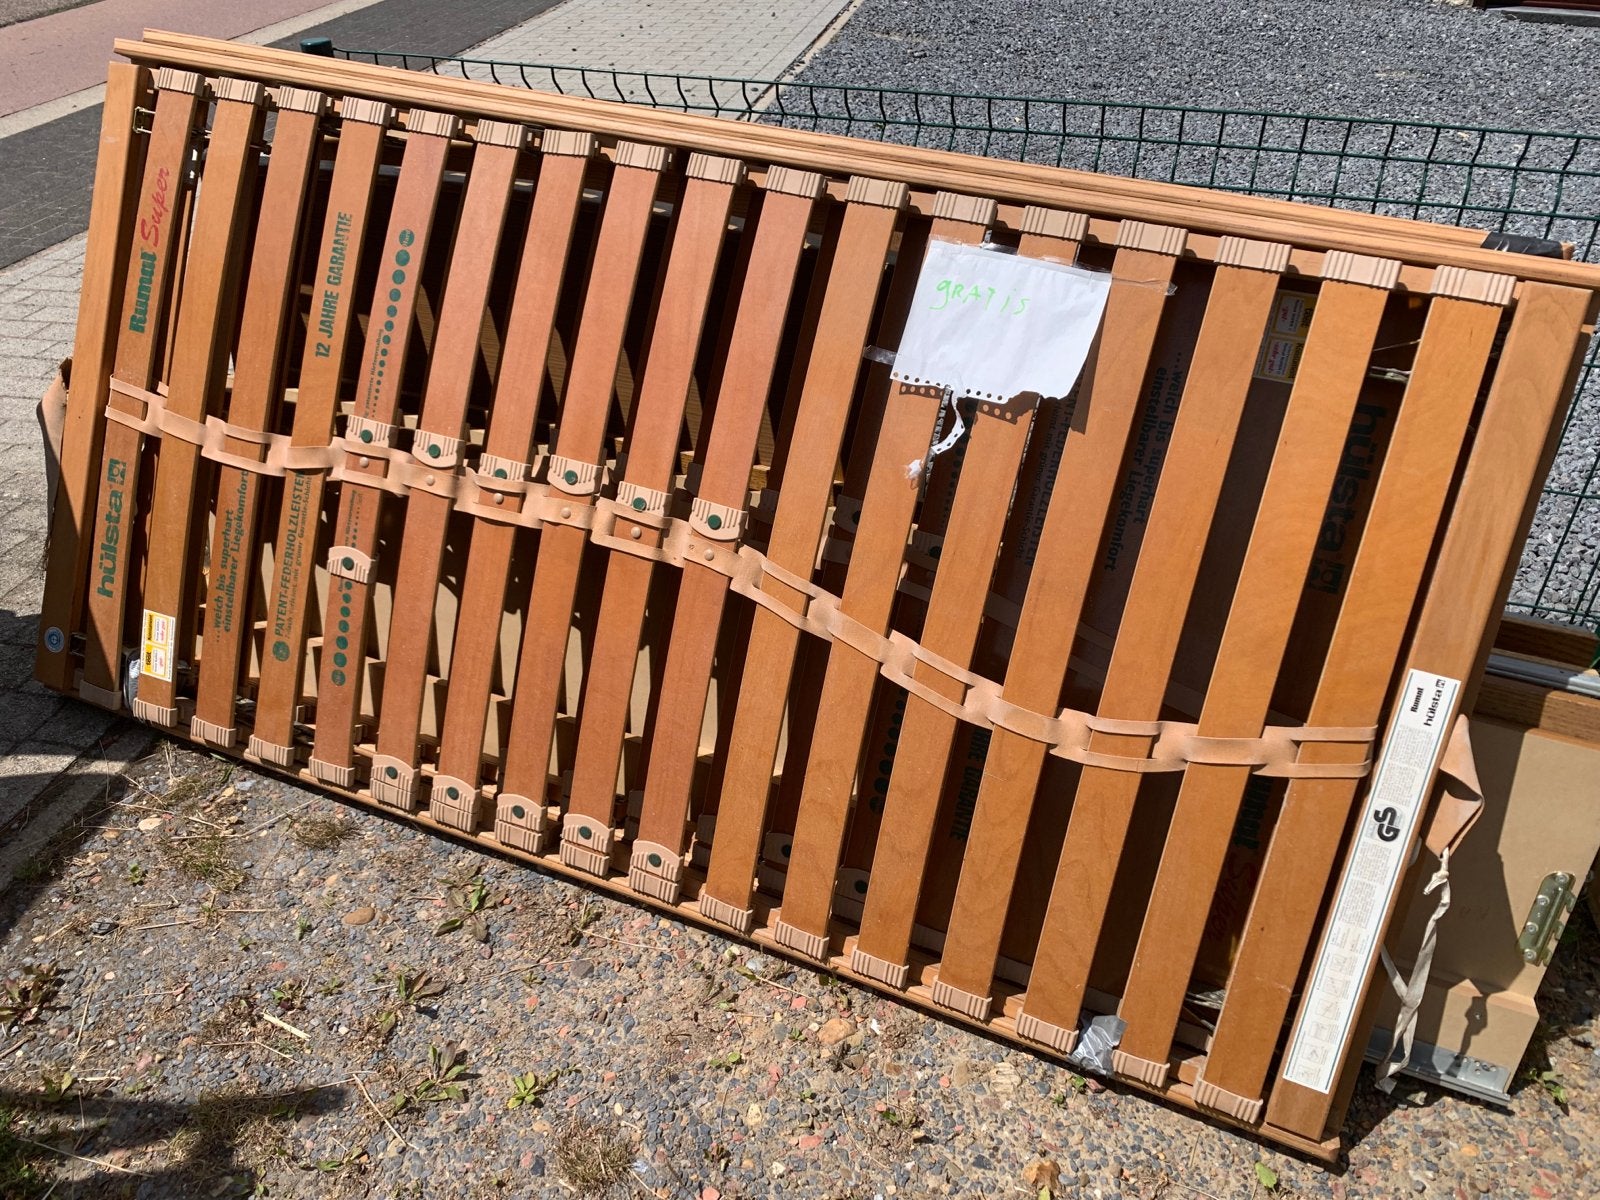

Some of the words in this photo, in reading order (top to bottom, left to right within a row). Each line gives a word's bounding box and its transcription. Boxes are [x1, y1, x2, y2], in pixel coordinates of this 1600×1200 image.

[141, 166, 169, 248] Super
[326, 211, 353, 286] GARANTIE
[315, 342, 331, 358] 12
[319, 290, 339, 339] JAHRE
[1133, 367, 1167, 466] einstellbarer
[1155, 420, 1173, 442] bis
[230, 470, 249, 552] Liegekomfort
[1133, 448, 1163, 524] superhart
[1320, 403, 1387, 552] hülsta
[97, 489, 123, 598] hülsta
[216, 574, 226, 591] bis
[221, 508, 234, 569] superhart
[274, 470, 304, 637] PATENT-FEDERHOLZLEISTEN
[1104, 470, 1144, 572] Liegekomfort
[224, 556, 238, 632] einstellbarer
[1423, 688, 1443, 727] hülsta
[949, 766, 983, 840] GARANTIE
[1373, 806, 1400, 842] GS
